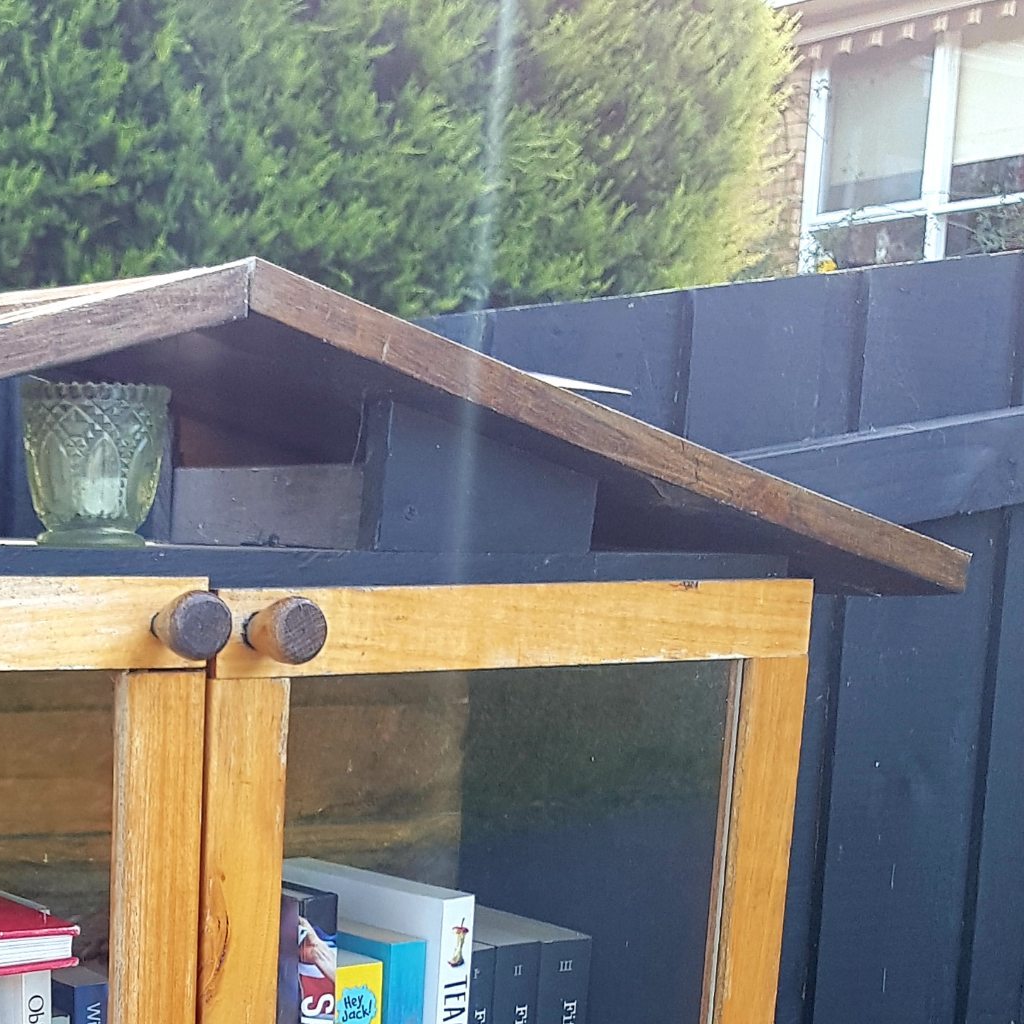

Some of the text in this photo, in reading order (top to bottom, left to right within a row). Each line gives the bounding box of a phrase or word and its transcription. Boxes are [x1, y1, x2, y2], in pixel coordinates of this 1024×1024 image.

[559, 961, 573, 972] III
[343, 995, 363, 1009] Hey
[341, 999, 373, 1022] Jack!
